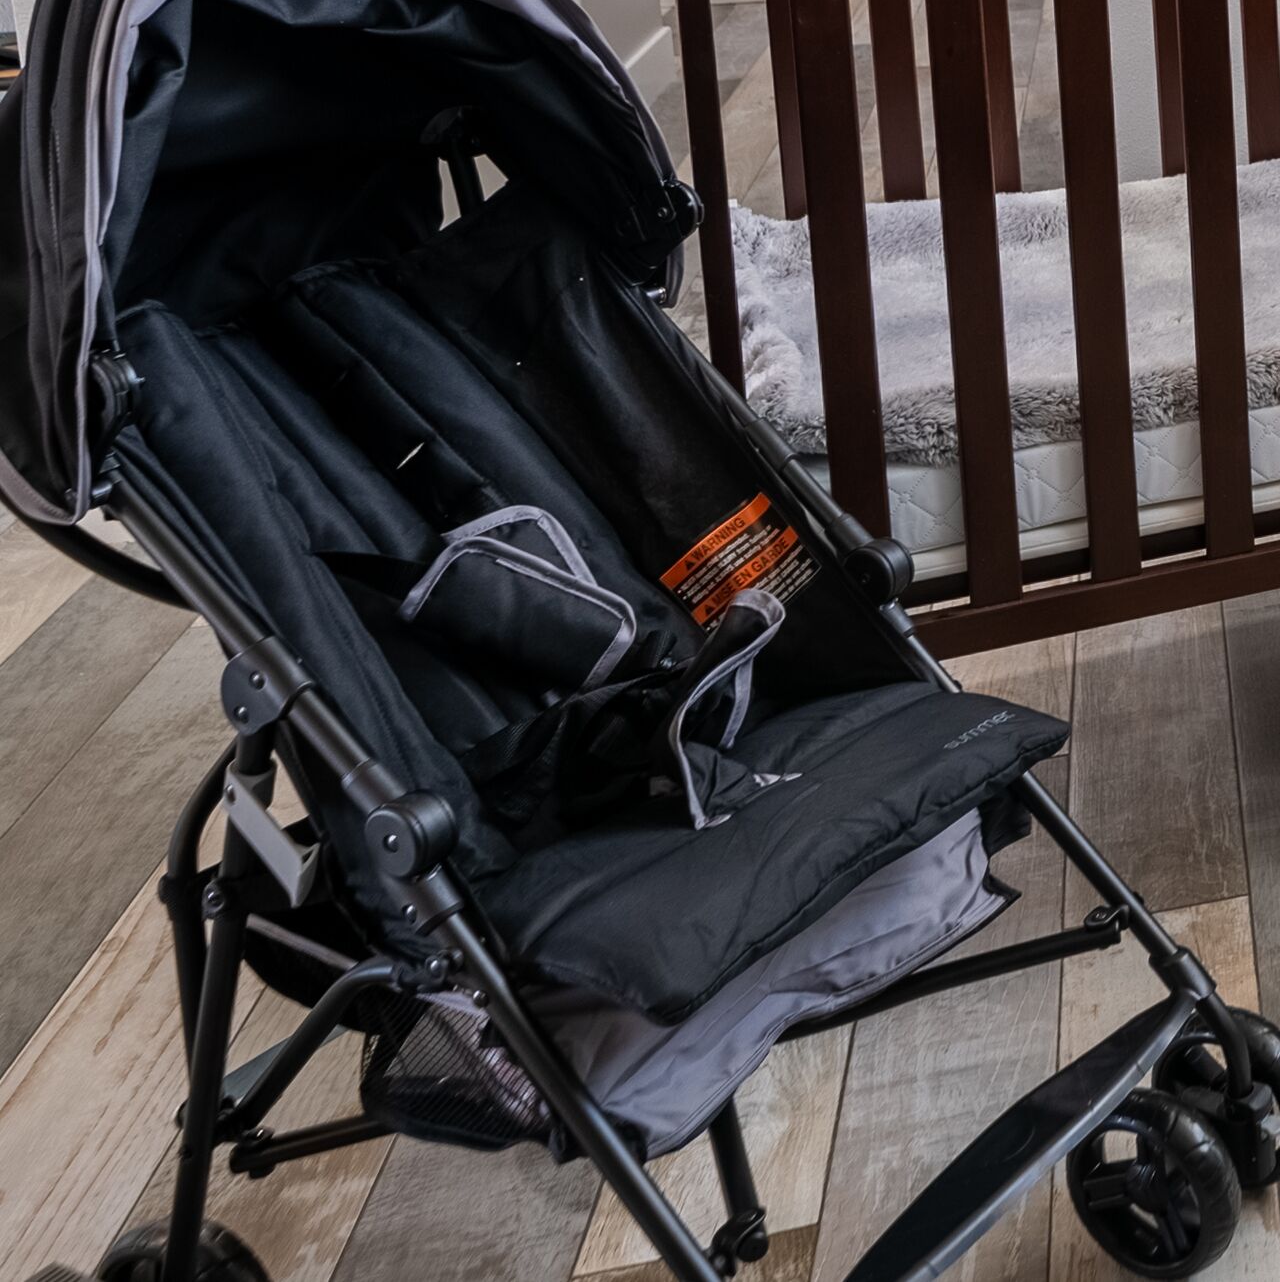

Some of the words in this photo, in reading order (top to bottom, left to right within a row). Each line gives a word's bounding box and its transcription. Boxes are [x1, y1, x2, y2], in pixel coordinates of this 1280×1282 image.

[691, 517, 745, 561] WARNING
[735, 568, 752, 587] EN
[750, 537, 788, 571] GARDE
[943, 710, 1016, 751] summer
